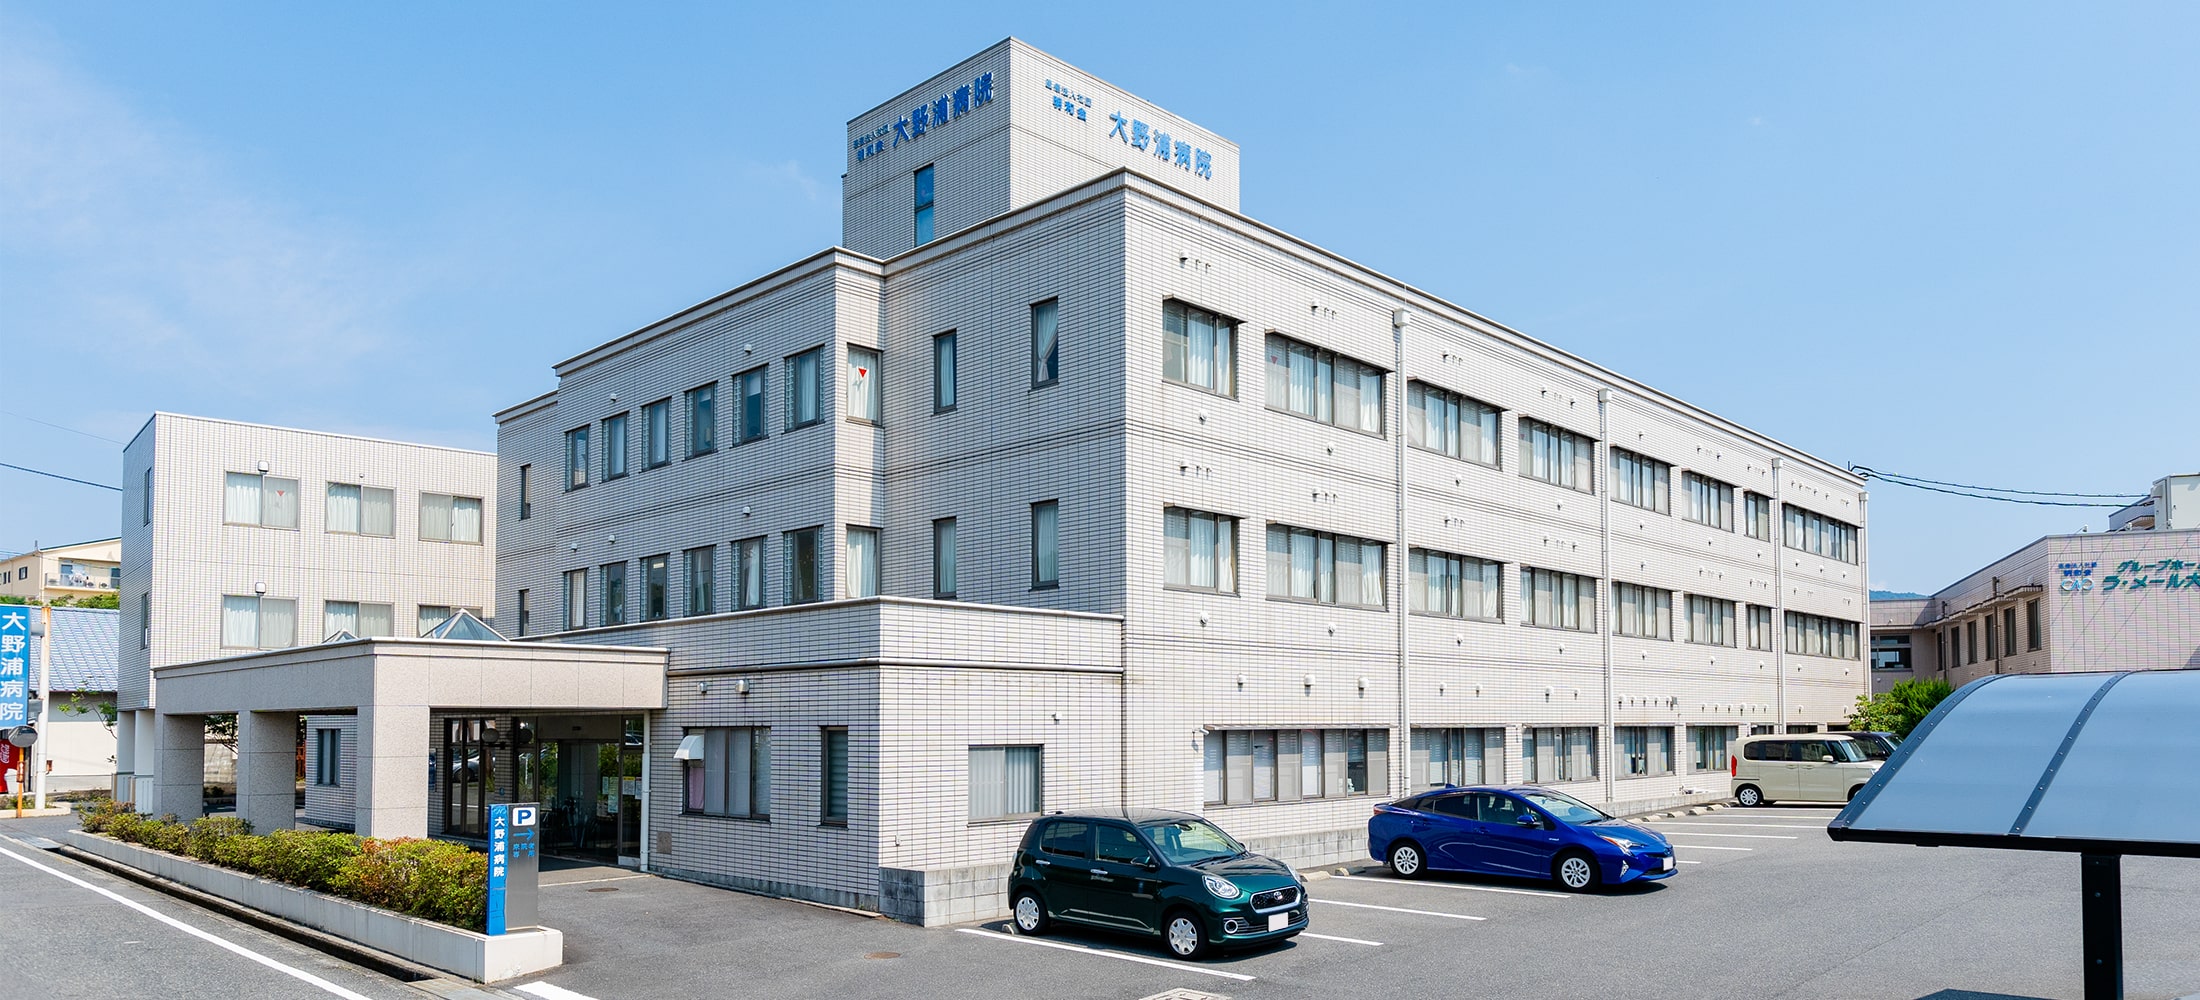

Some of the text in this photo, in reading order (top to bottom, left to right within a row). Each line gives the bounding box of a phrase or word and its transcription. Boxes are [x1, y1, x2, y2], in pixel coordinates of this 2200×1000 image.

[892, 71, 994, 148] 大野浦病院
[1109, 110, 1213, 181] 大野浦病院
[2116, 559, 2200, 573] グループホー
[0, 611, 26, 721] 大野浦病院
[494, 817, 505, 877] 大野浦病院
[518, 810, 531, 824] P
